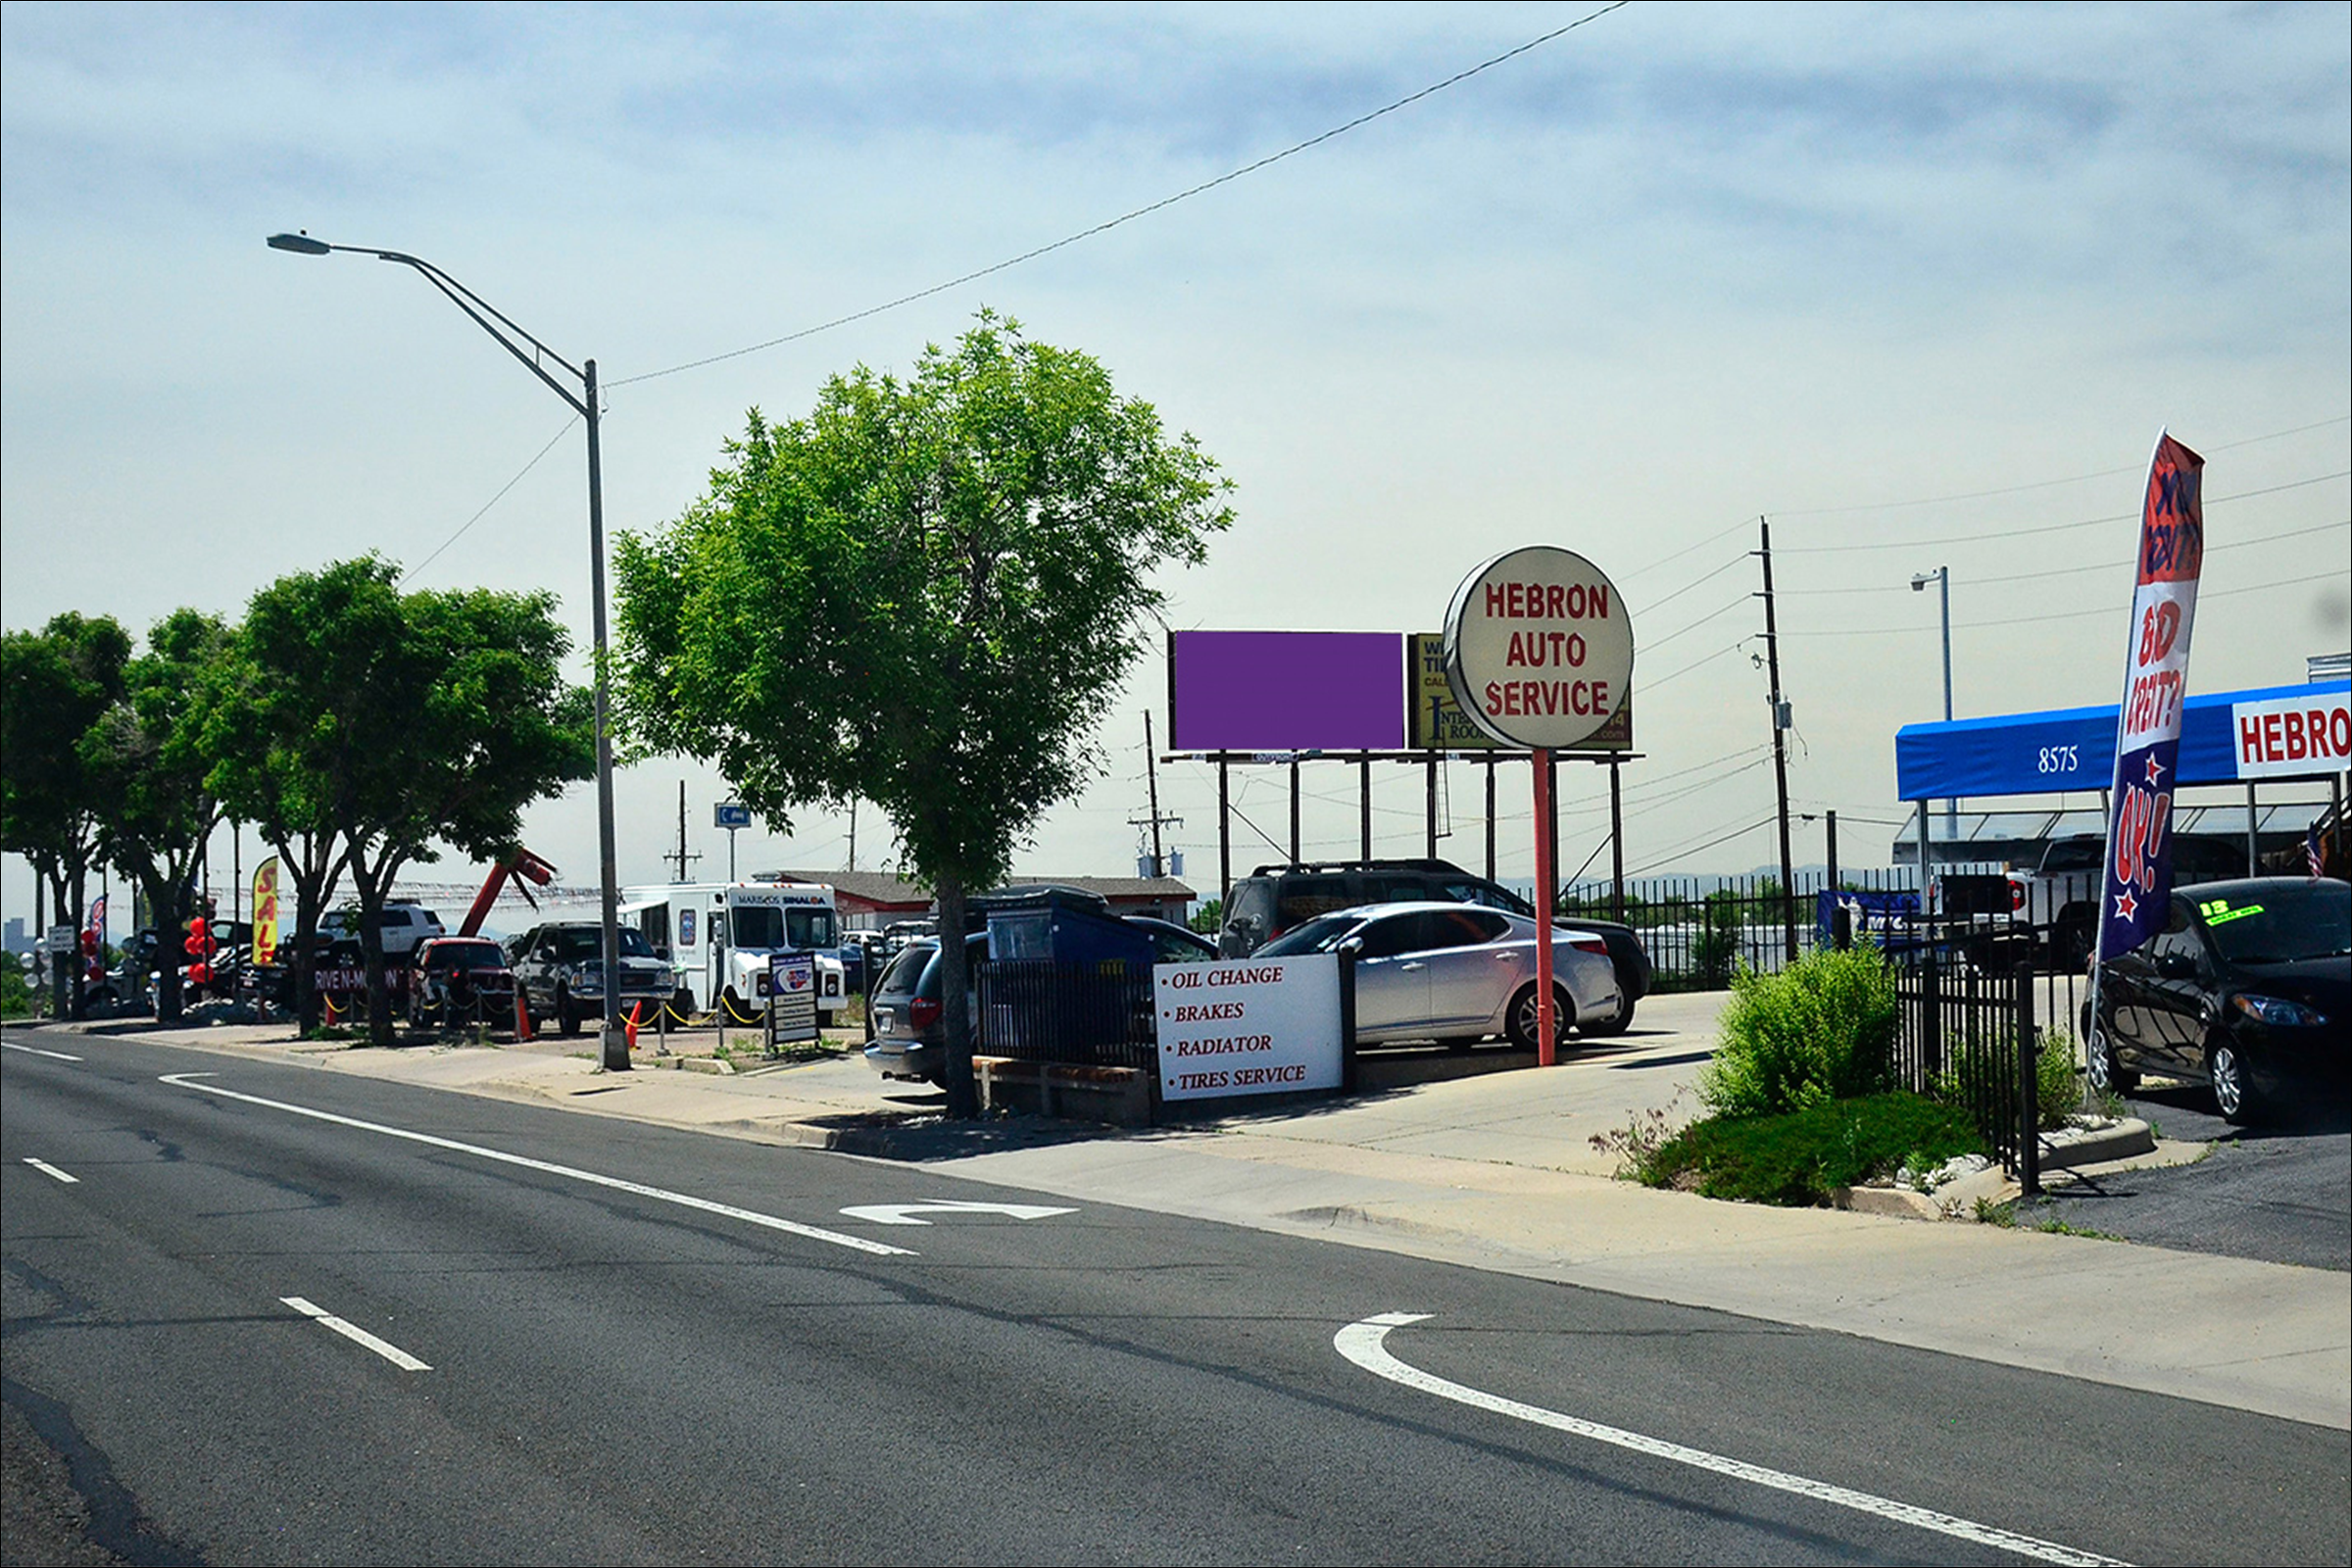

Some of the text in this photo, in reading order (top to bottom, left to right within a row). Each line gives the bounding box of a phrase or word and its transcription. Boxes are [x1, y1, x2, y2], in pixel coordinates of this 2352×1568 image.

[1486, 583, 1608, 619] HEBRON
[2138, 601, 2181, 667] BD
[1506, 632, 1586, 667] AUTO
[1486, 680, 1609, 715] SERVICE
[2240, 708, 2351, 763] HEBRO
[2038, 745, 2078, 773] 8575
[2199, 900, 2230, 917] 13
[1172, 966, 1283, 989] OIL CHANGE
[1175, 1002, 1244, 1022] BRAKES
[1177, 1035, 1271, 1057] RADIATOR
[1179, 1065, 1305, 1090] TIRES SERVICE
